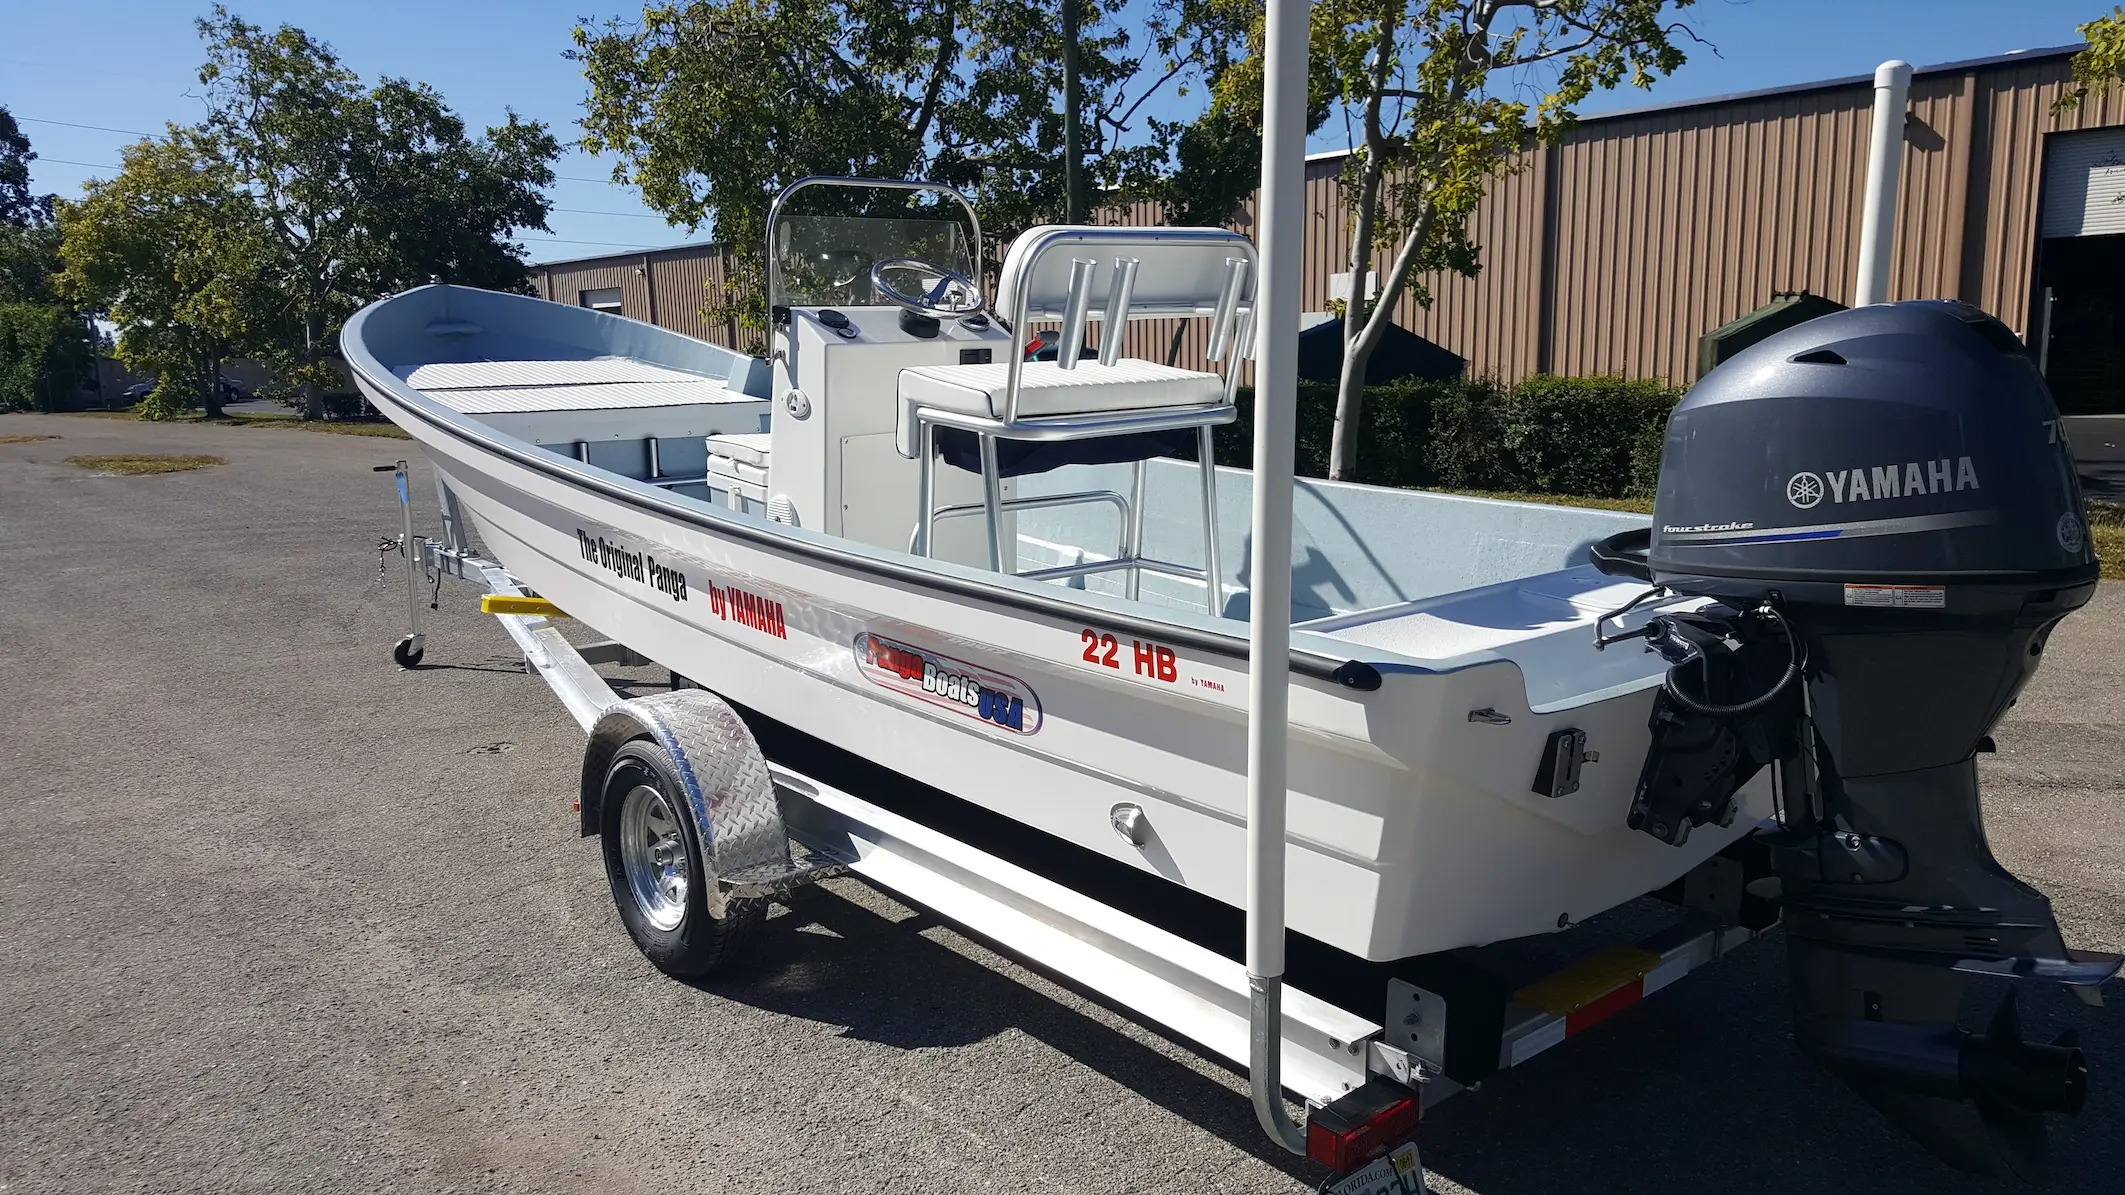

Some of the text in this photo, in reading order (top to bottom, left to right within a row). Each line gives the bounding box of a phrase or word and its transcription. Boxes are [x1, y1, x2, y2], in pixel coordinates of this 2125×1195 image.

[1825, 456, 1979, 503] YAMAHA
[576, 528, 688, 602] The Original Panga
[708, 579, 788, 640] by YAMAHA
[1081, 628, 1178, 683] 22 HB
[1191, 677, 1225, 693] by YAMAHA
